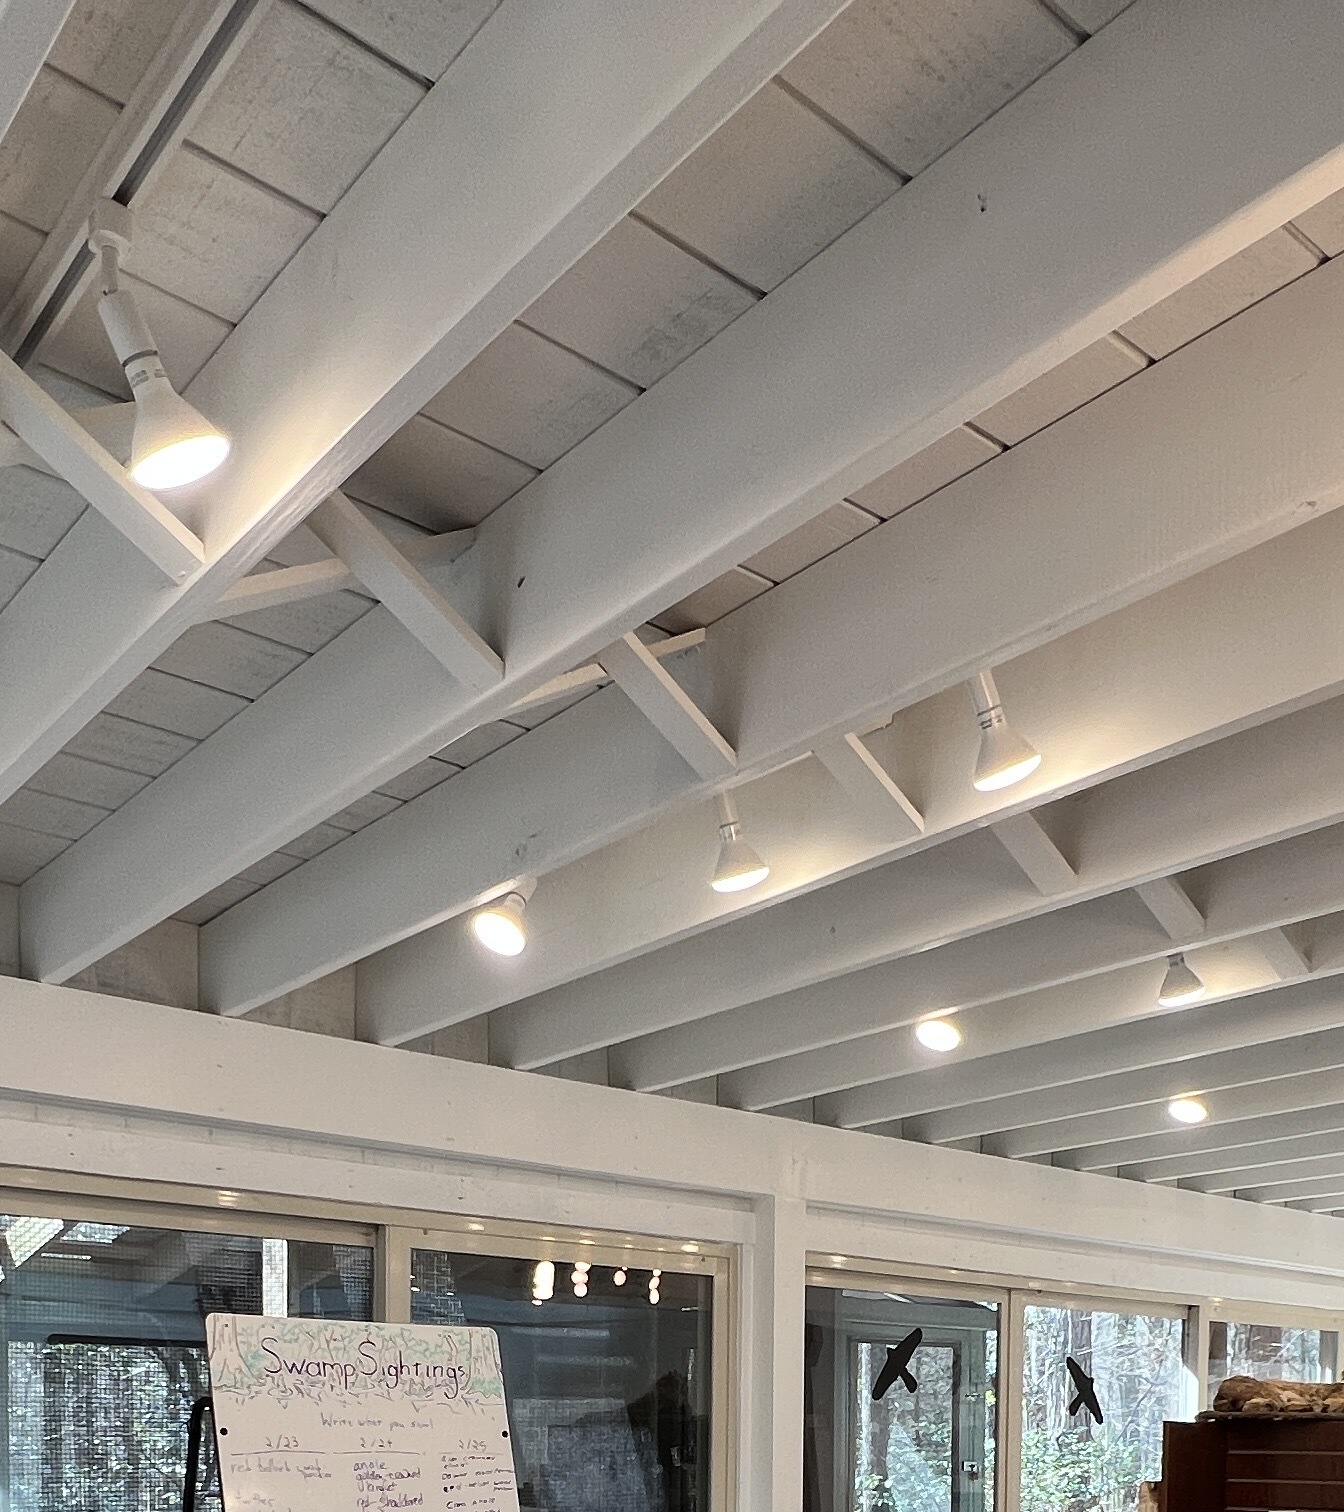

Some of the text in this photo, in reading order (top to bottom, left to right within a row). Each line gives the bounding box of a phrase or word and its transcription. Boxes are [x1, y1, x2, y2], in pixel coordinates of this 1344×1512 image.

[260, 1337, 466, 1399] Swamp Sightings
[265, 1434, 299, 1449] 2/23
[359, 1436, 392, 1449] 2/24
[458, 1439, 487, 1452] 2/25
[231, 1458, 252, 1473] red
[353, 1460, 389, 1471] anole
